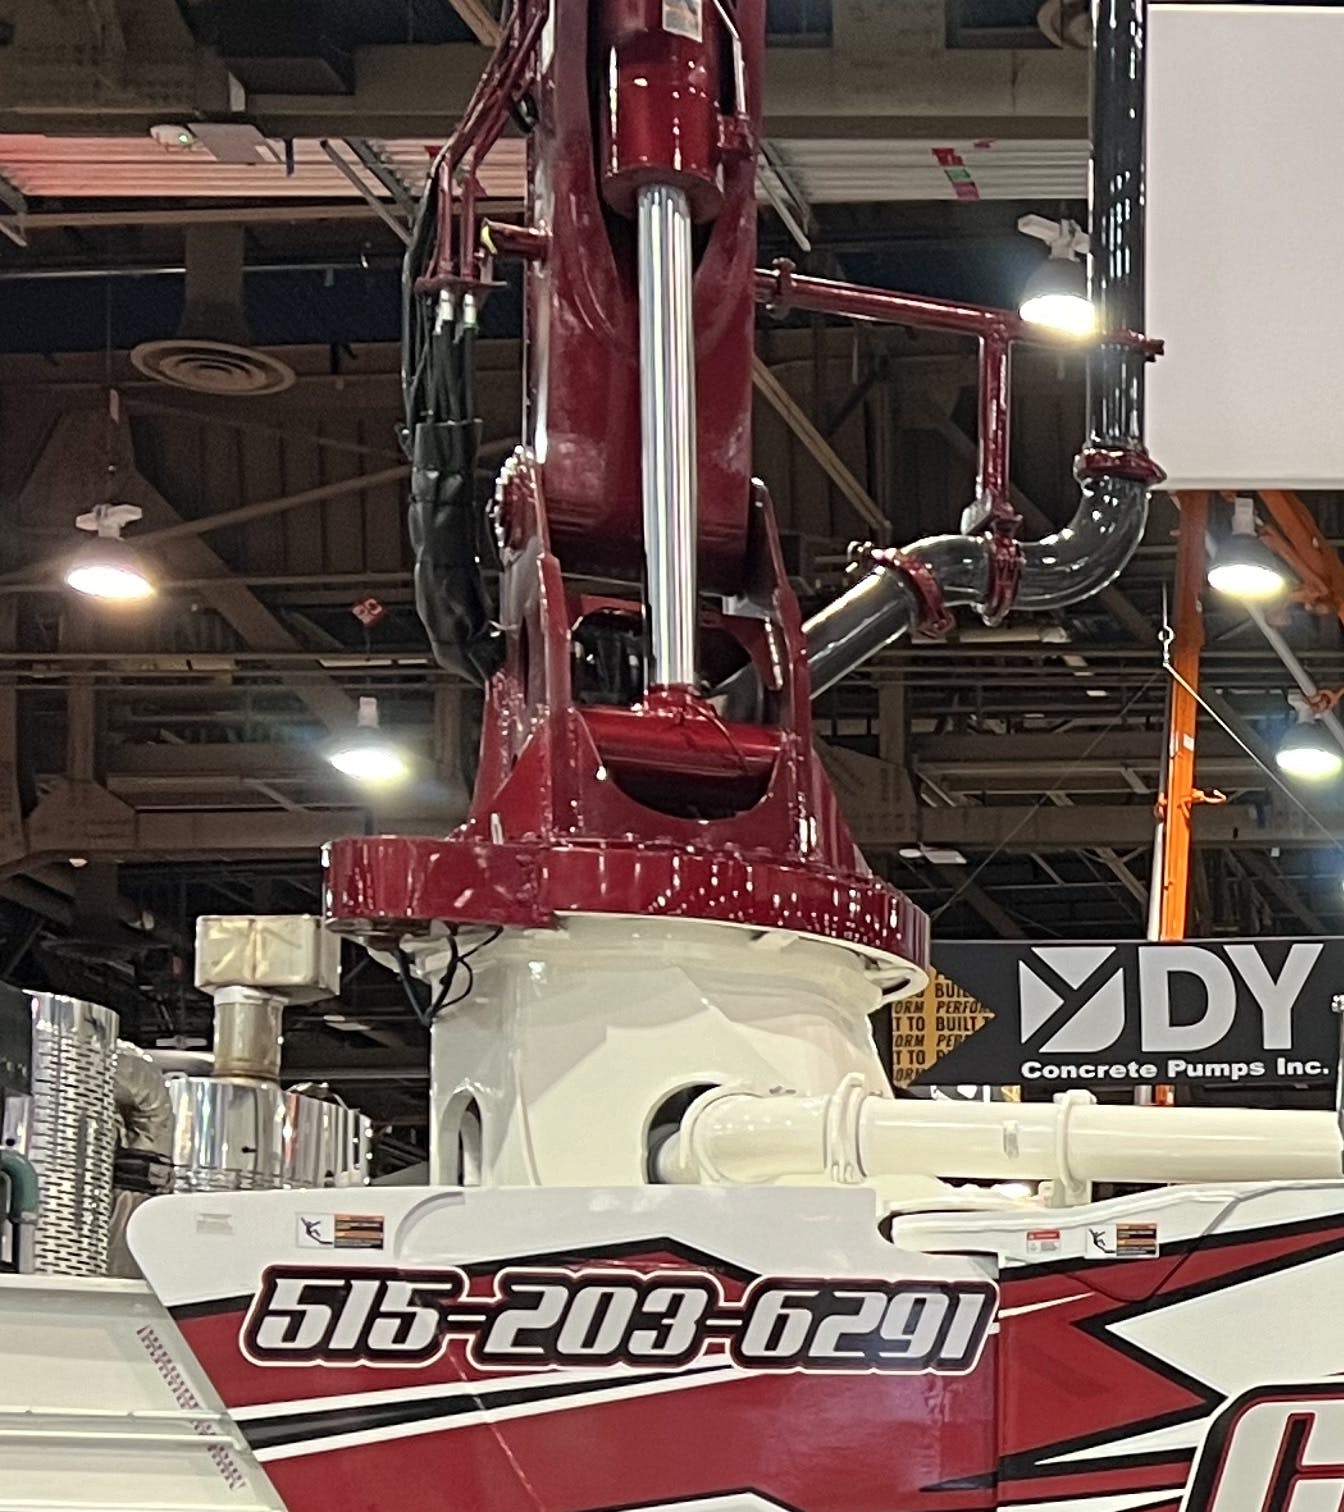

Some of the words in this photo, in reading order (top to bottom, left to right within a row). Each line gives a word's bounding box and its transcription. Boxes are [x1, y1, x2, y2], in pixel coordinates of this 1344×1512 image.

[936, 1000, 991, 1014] PERFO
[1138, 943, 1325, 1053] DY
[936, 1016, 977, 1032] BUILT
[1021, 1060, 1158, 1079] Concrete
[1167, 1058, 1266, 1081] Pumps
[1276, 1057, 1330, 1076] Inc.
[254, 1279, 985, 1360] 515-203-6291
